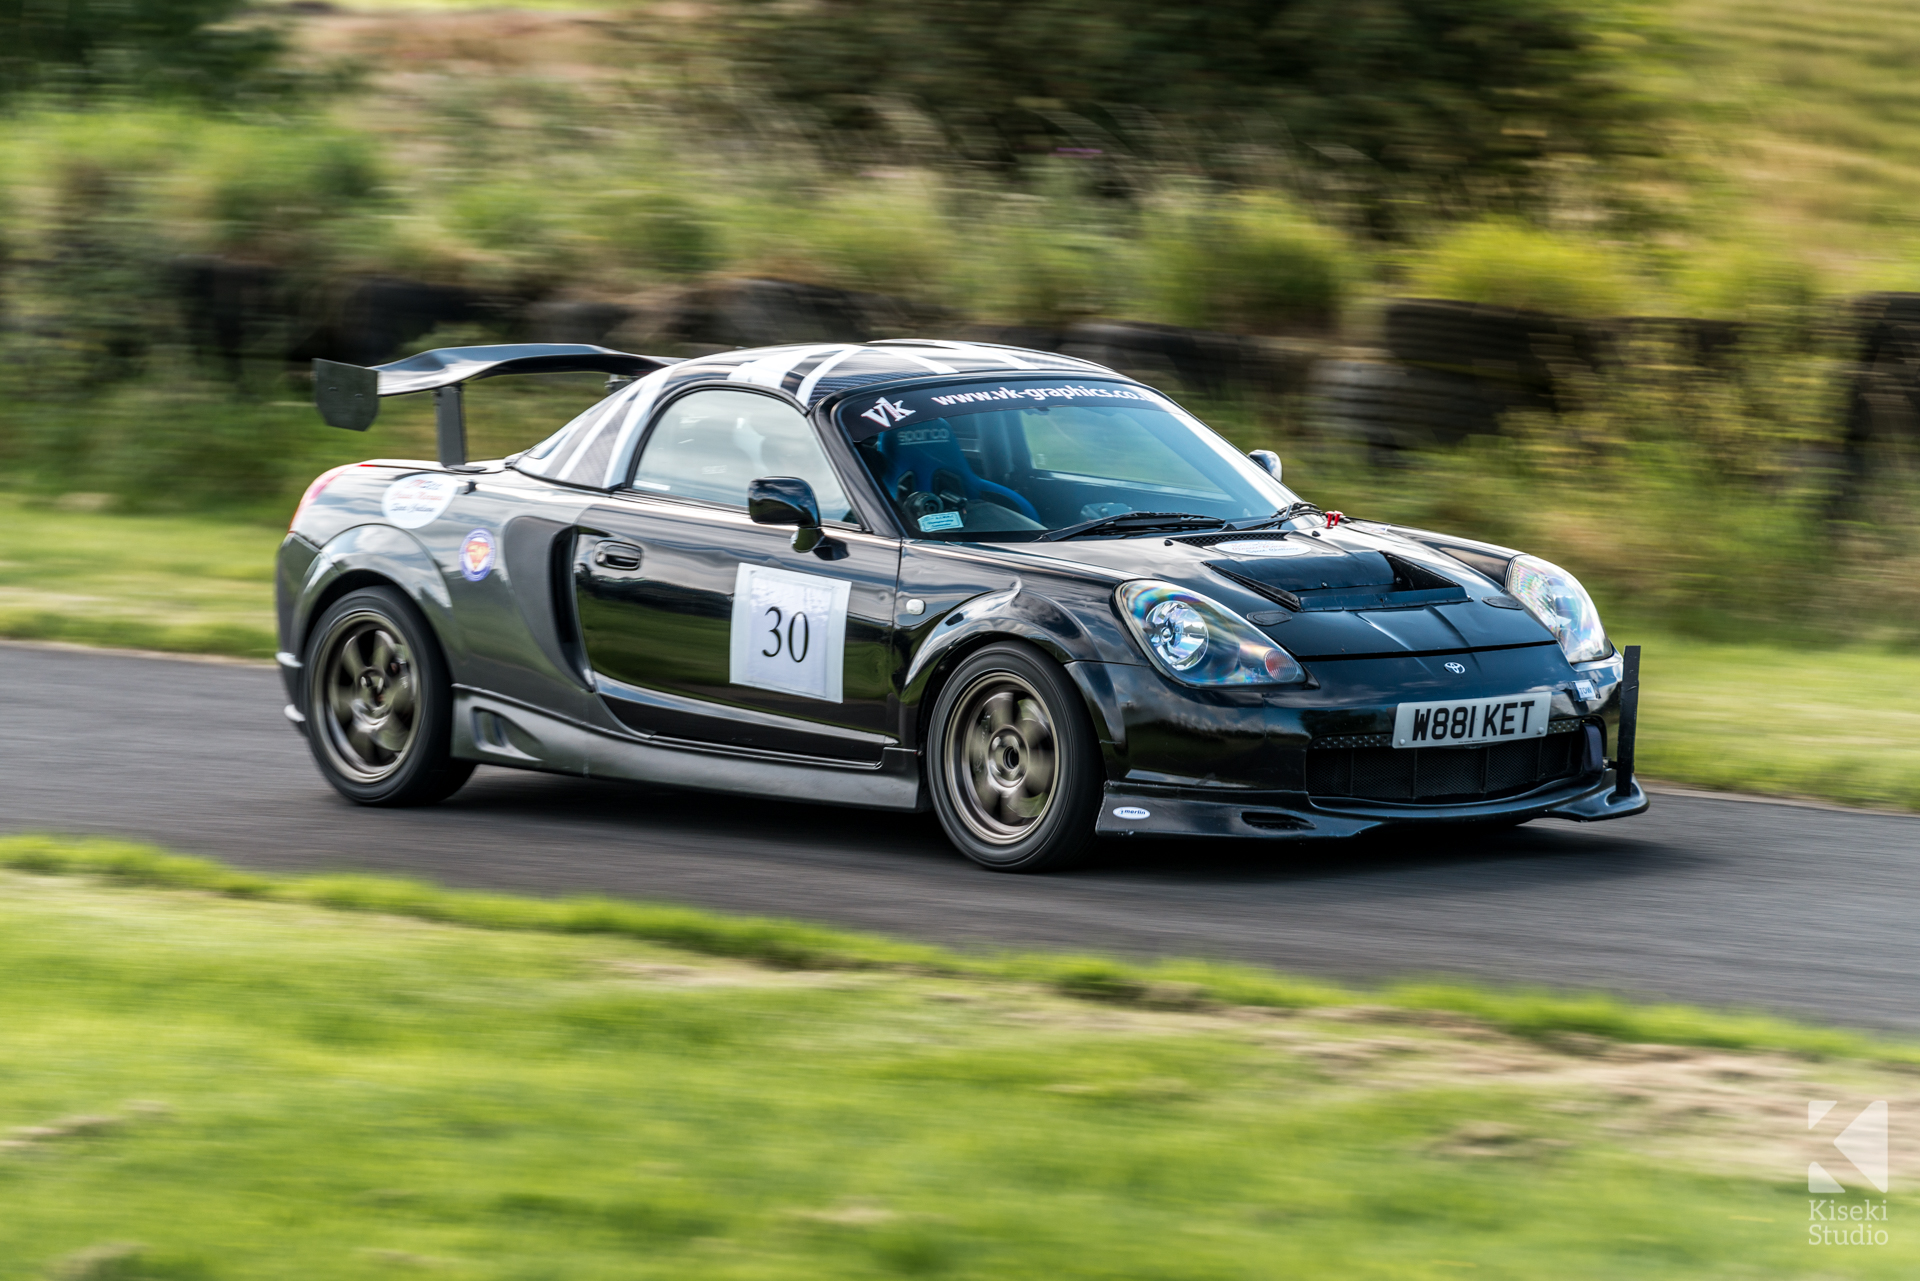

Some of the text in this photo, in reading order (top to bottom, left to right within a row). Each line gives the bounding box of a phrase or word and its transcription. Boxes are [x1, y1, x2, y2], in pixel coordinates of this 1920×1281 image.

[897, 428, 950, 445] sparco
[762, 606, 809, 663] 30
[1578, 686, 1593, 695] TOW
[1412, 700, 1535, 741] W881 KET
